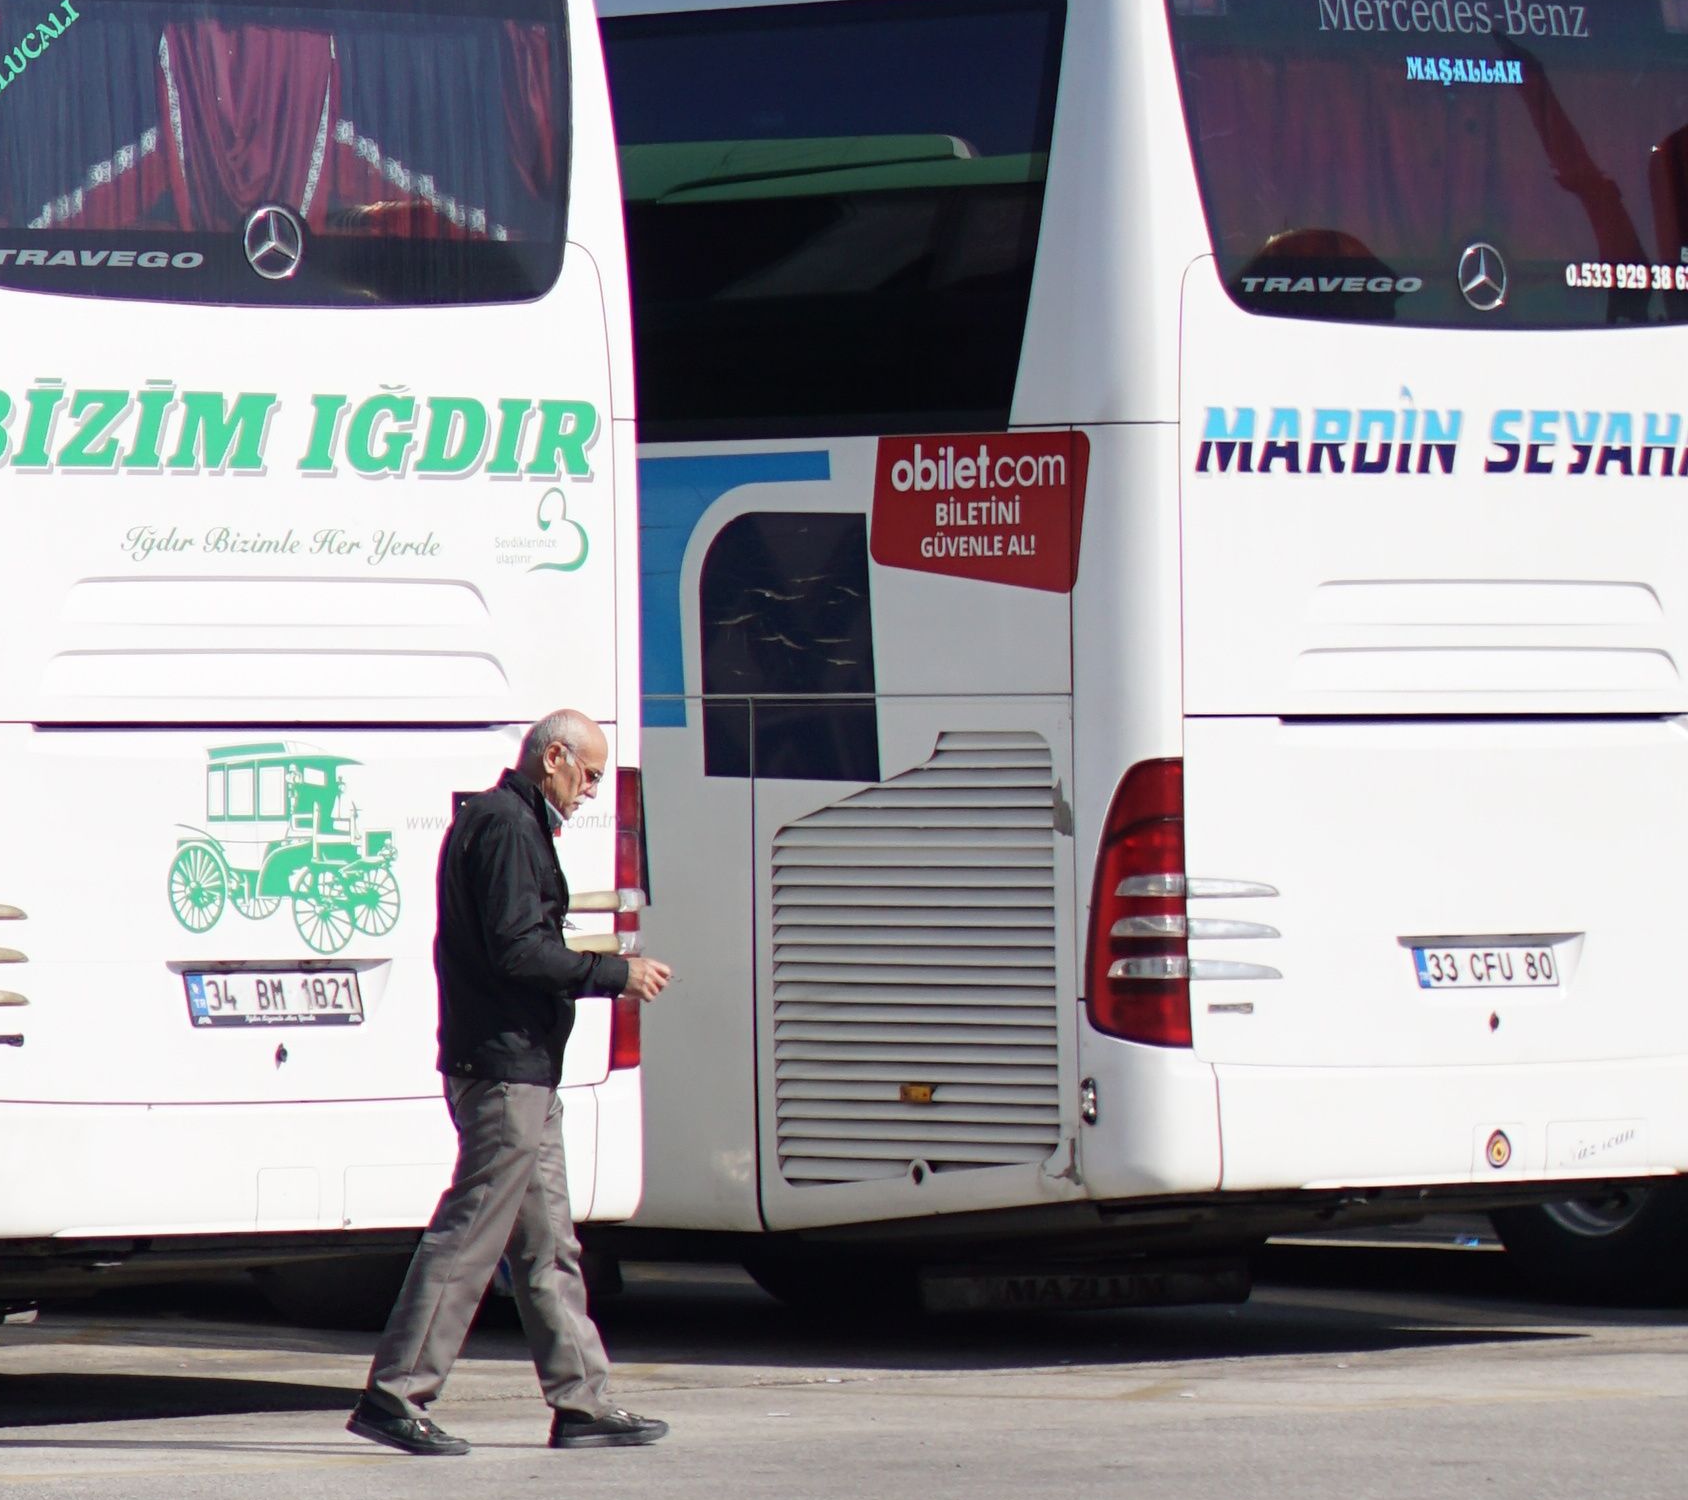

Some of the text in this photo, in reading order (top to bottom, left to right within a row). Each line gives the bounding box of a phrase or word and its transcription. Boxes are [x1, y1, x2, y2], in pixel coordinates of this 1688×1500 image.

[1406, 56, 1523, 85] MAŞALLAH
[1241, 277, 1423, 293] TRAVEGO
[1566, 262, 1612, 288] 0.533
[1616, 263, 1647, 289] 929
[1651, 264, 1672, 290] 38
[297, 384, 602, 482] IĞDIR
[1194, 384, 1688, 477] MARDİN SEYAH
[891, 444, 1065, 492] obilet.com
[935, 495, 1021, 526] BİLETİNİ
[120, 525, 441, 566] Iğdır Bizimle Her Yerde
[920, 532, 1036, 558] GÜVENLE AL!
[1429, 952, 1553, 981] 33 CFU 80
[205, 979, 237, 1011] 34
[255, 978, 287, 1010] BM
[301, 978, 355, 1010] 1821
